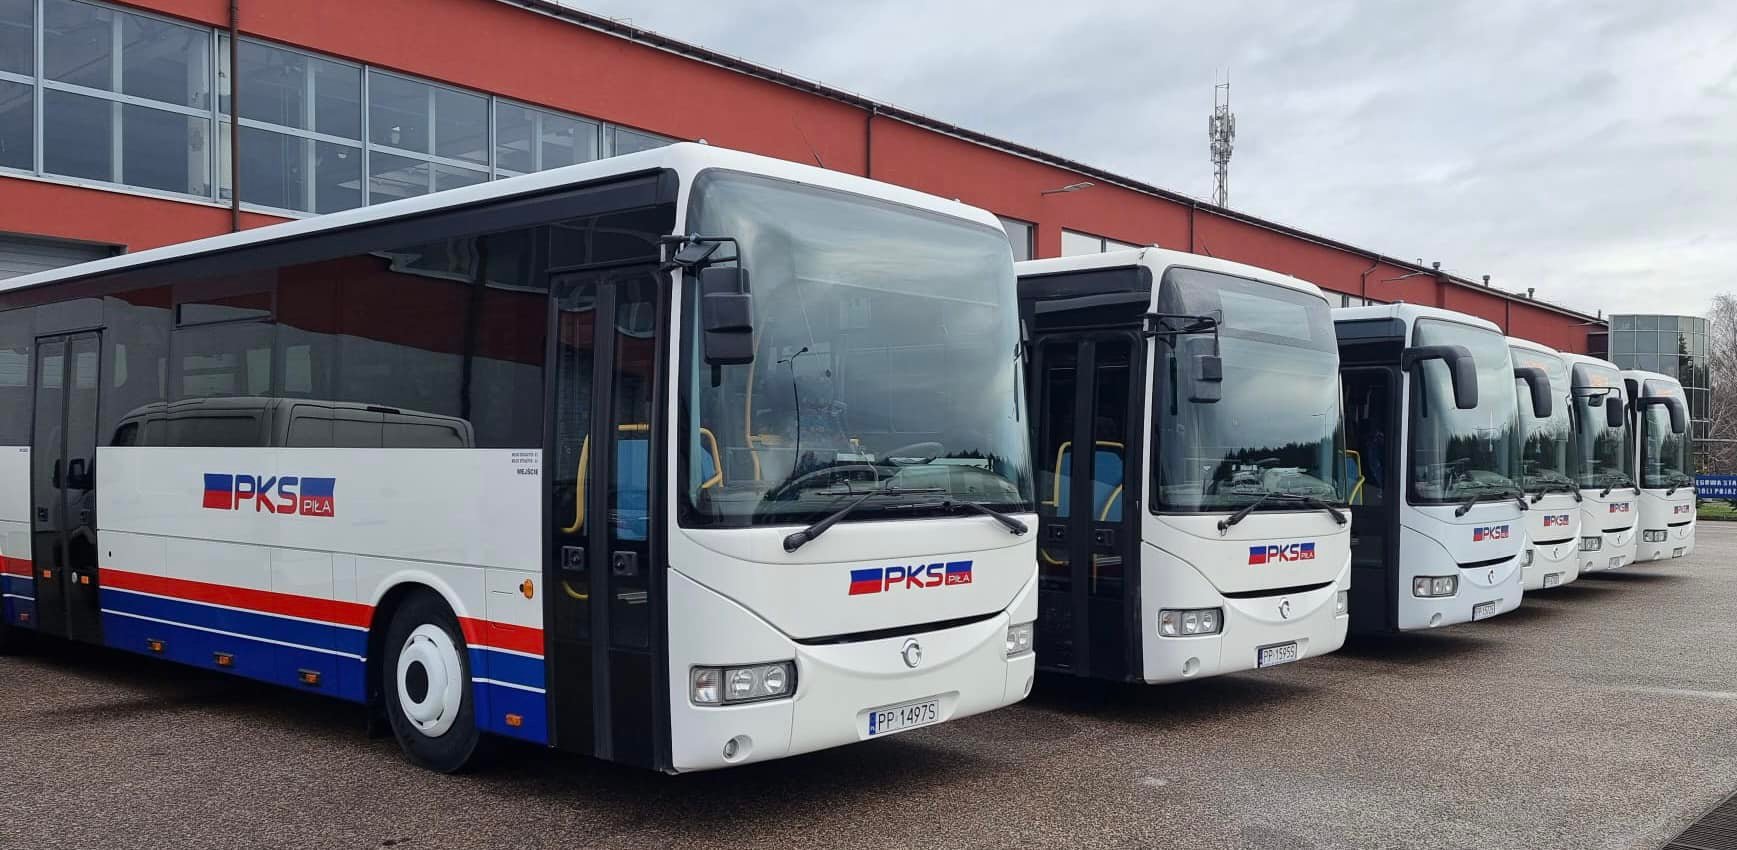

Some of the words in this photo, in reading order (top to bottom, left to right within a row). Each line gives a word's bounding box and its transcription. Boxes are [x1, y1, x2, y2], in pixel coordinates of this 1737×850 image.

[234, 474, 299, 514] PKS
[303, 499, 331, 513] PIŁA
[1483, 525, 1501, 540] PKS
[1268, 543, 1300, 563] PKS
[885, 563, 944, 592] PKS
[947, 574, 971, 584] PIŁA
[1263, 649, 1273, 663] PP
[878, 711, 895, 731] PP
[901, 703, 936, 726] 1497S
